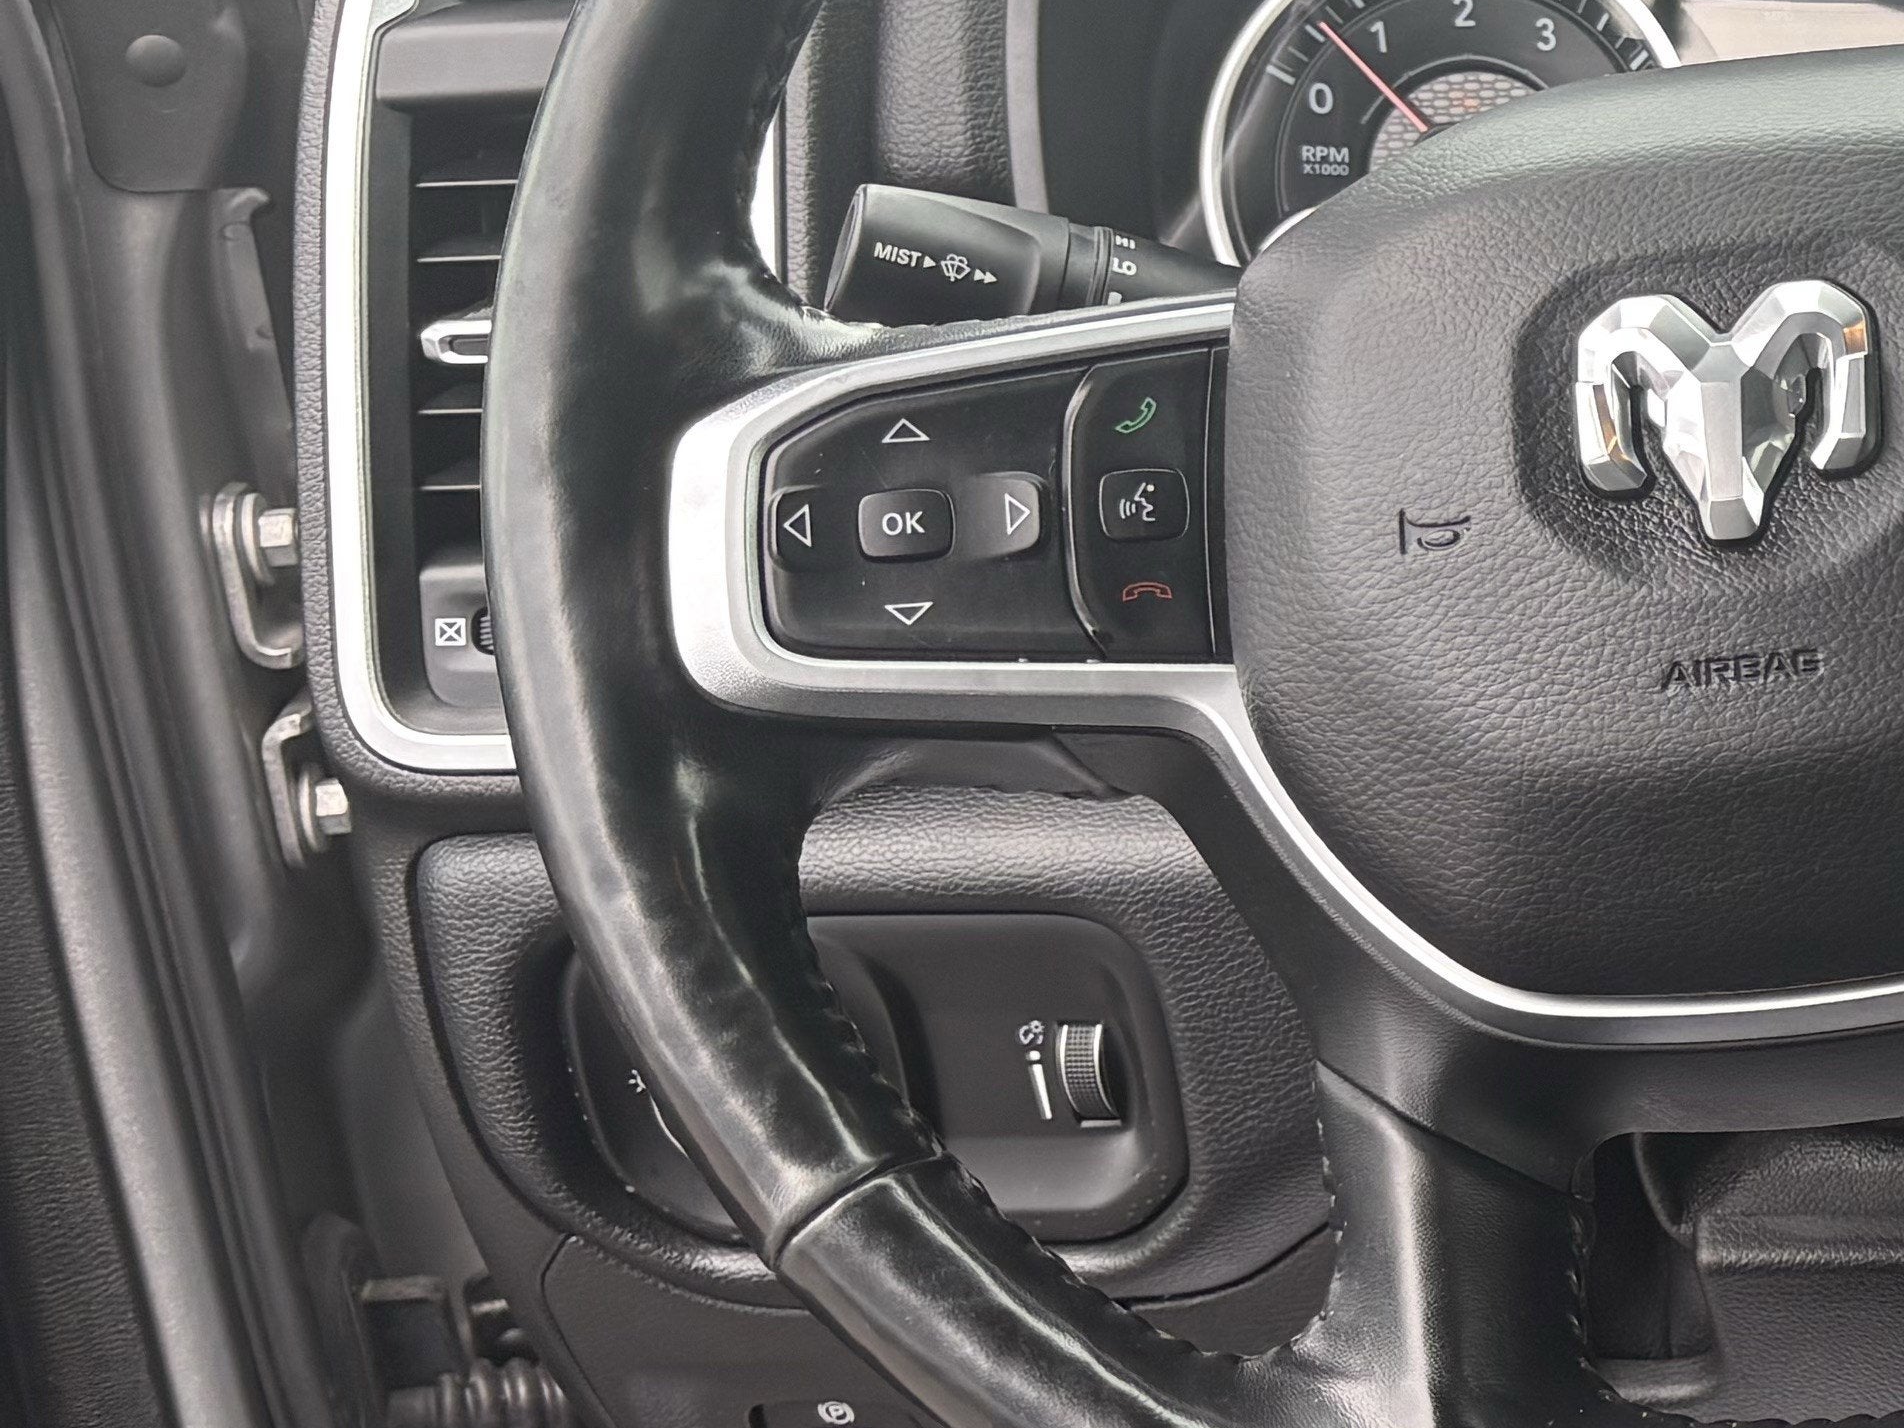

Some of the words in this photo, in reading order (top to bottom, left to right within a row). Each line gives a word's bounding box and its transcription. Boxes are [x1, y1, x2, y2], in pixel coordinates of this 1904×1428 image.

[1370, 21, 1388, 52] 1
[1537, 18, 1557, 51] 3
[1308, 83, 1334, 114] 0
[1301, 144, 1350, 164] RPM
[874, 243, 921, 268] MIST
[882, 511, 925, 535] OK
[1661, 648, 1825, 692] AIRBAG
